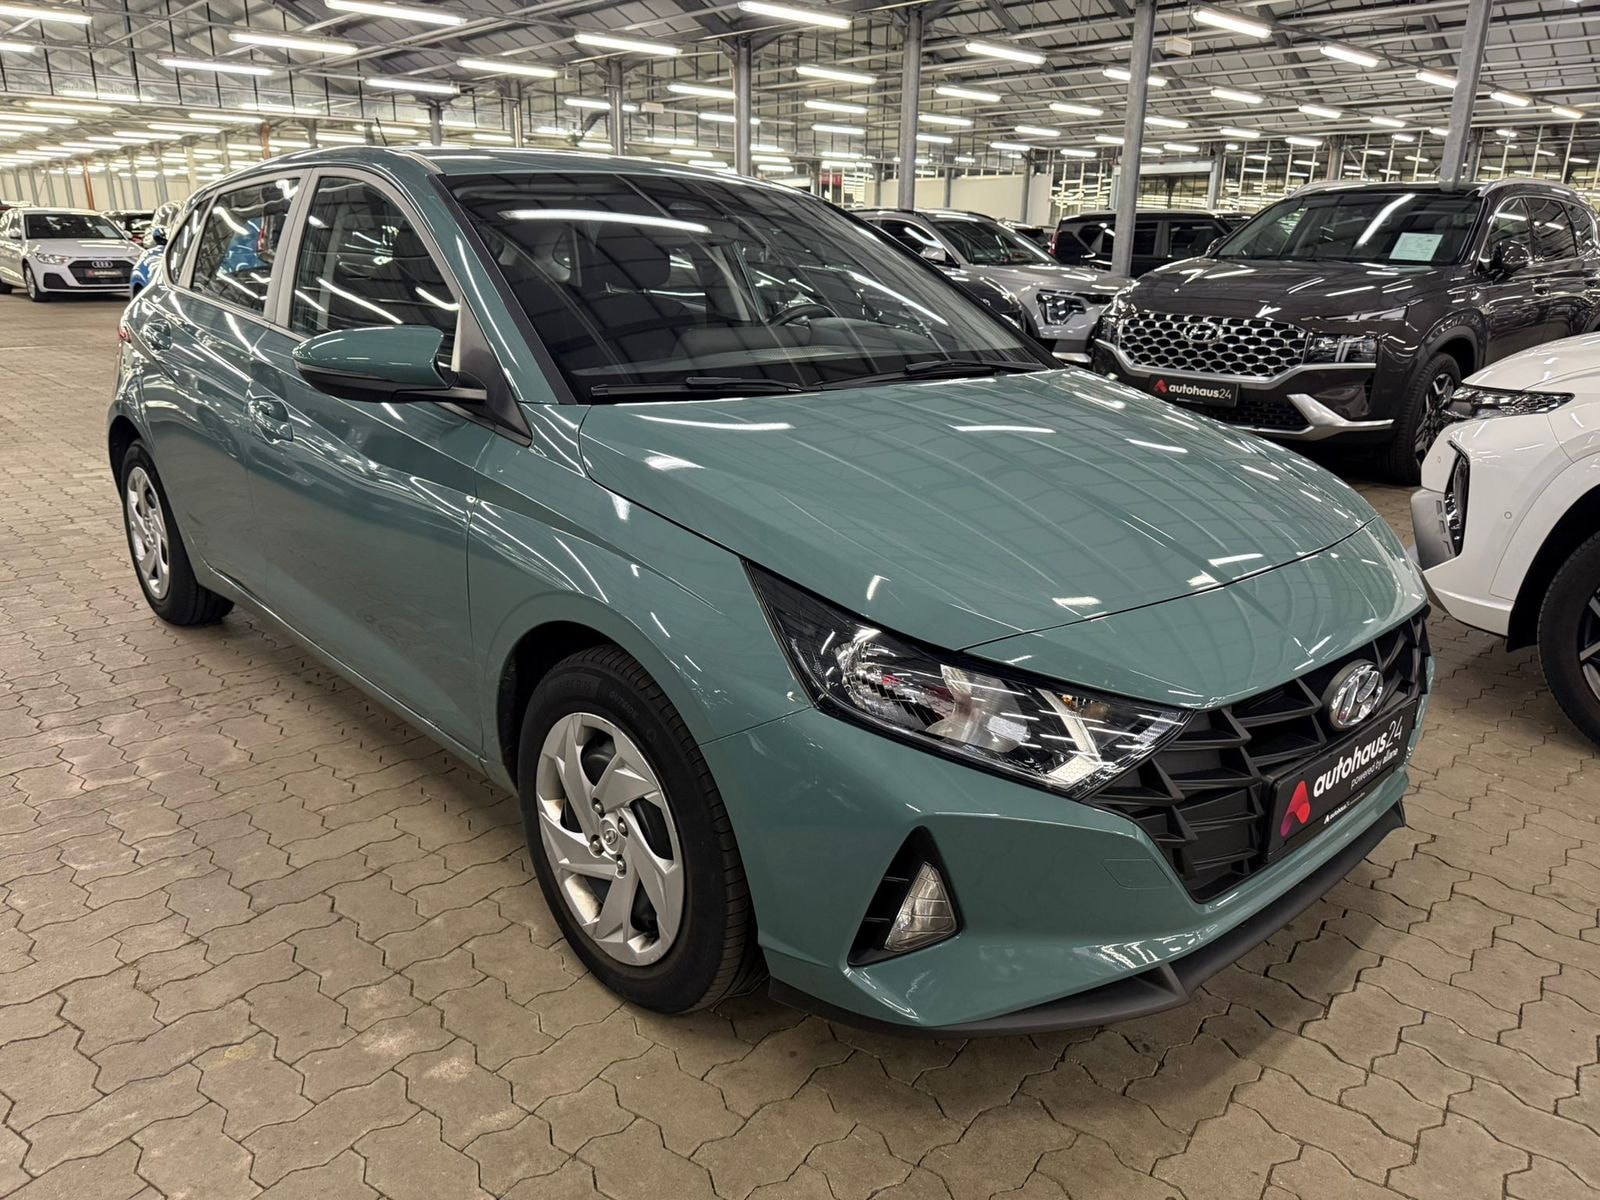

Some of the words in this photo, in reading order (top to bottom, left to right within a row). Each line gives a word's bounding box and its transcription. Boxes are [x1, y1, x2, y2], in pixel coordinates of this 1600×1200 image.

[1169, 384, 1232, 400] autohaus24
[1313, 715, 1403, 798] autohaus24
[1350, 762, 1375, 790] powered
